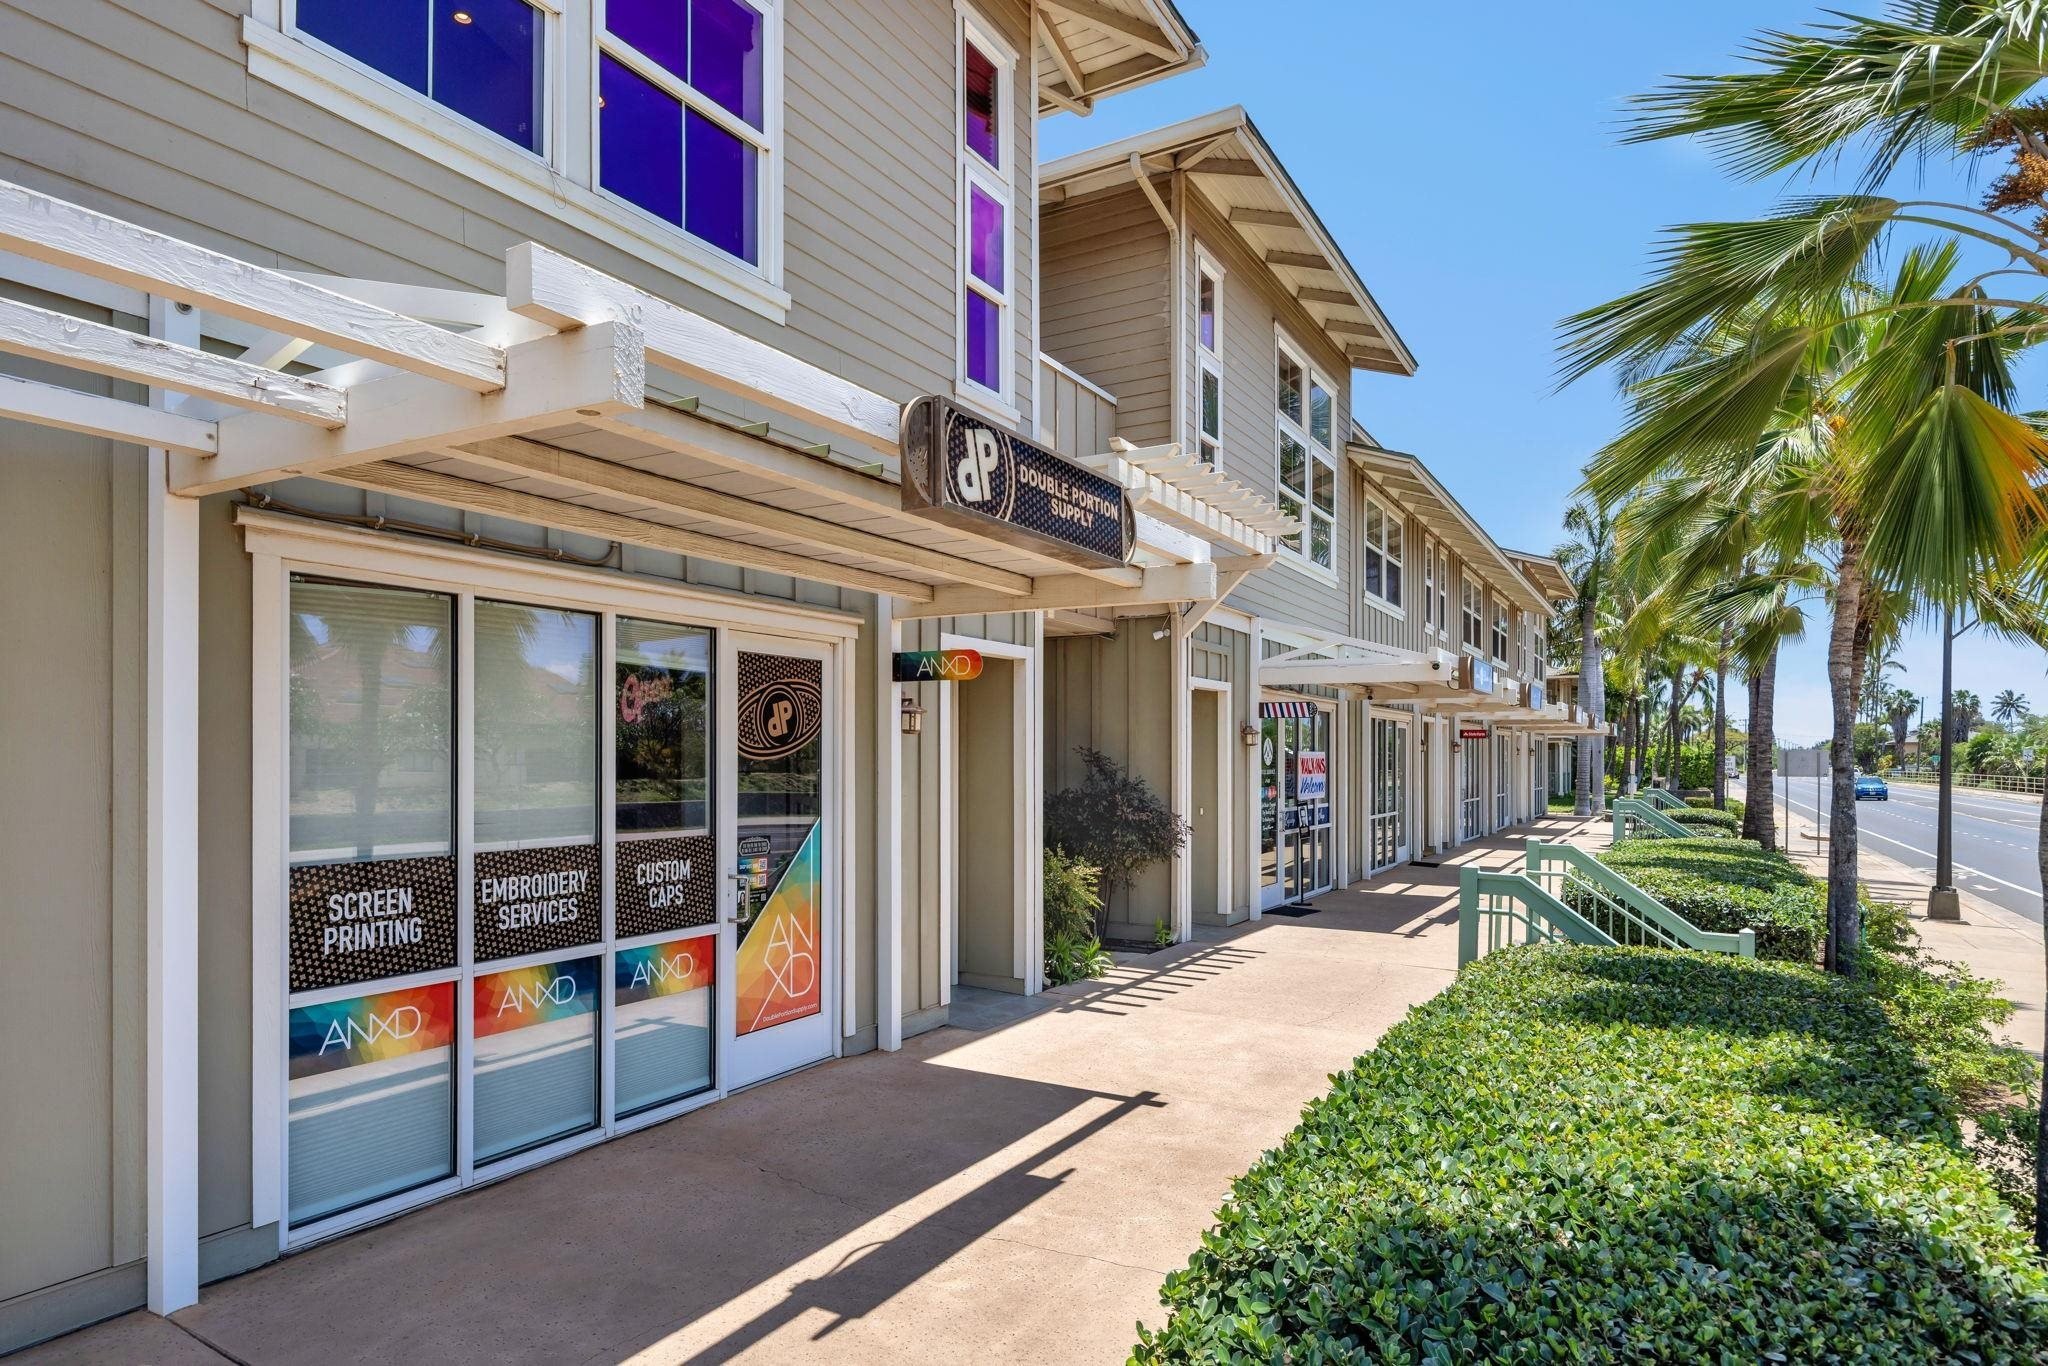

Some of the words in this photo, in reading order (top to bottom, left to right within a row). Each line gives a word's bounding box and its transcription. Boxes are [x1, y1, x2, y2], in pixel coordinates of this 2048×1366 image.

[1019, 465, 1069, 501] DOUBLE
[1072, 488, 1119, 521] PORTION
[1051, 500, 1093, 529] SUPPLY
[916, 655, 971, 677] ANXD
[481, 869, 589, 904] EMBROIDERY
[636, 859, 691, 885] CUSTOM
[329, 887, 413, 922] SCREEN
[498, 898, 578, 930] SERVICES
[649, 884, 684, 909] CAPS
[324, 916, 422, 957] PRINTING
[630, 952, 694, 990] ANXD
[497, 975, 577, 1018] ANXD
[318, 1005, 423, 1056] ANXD
